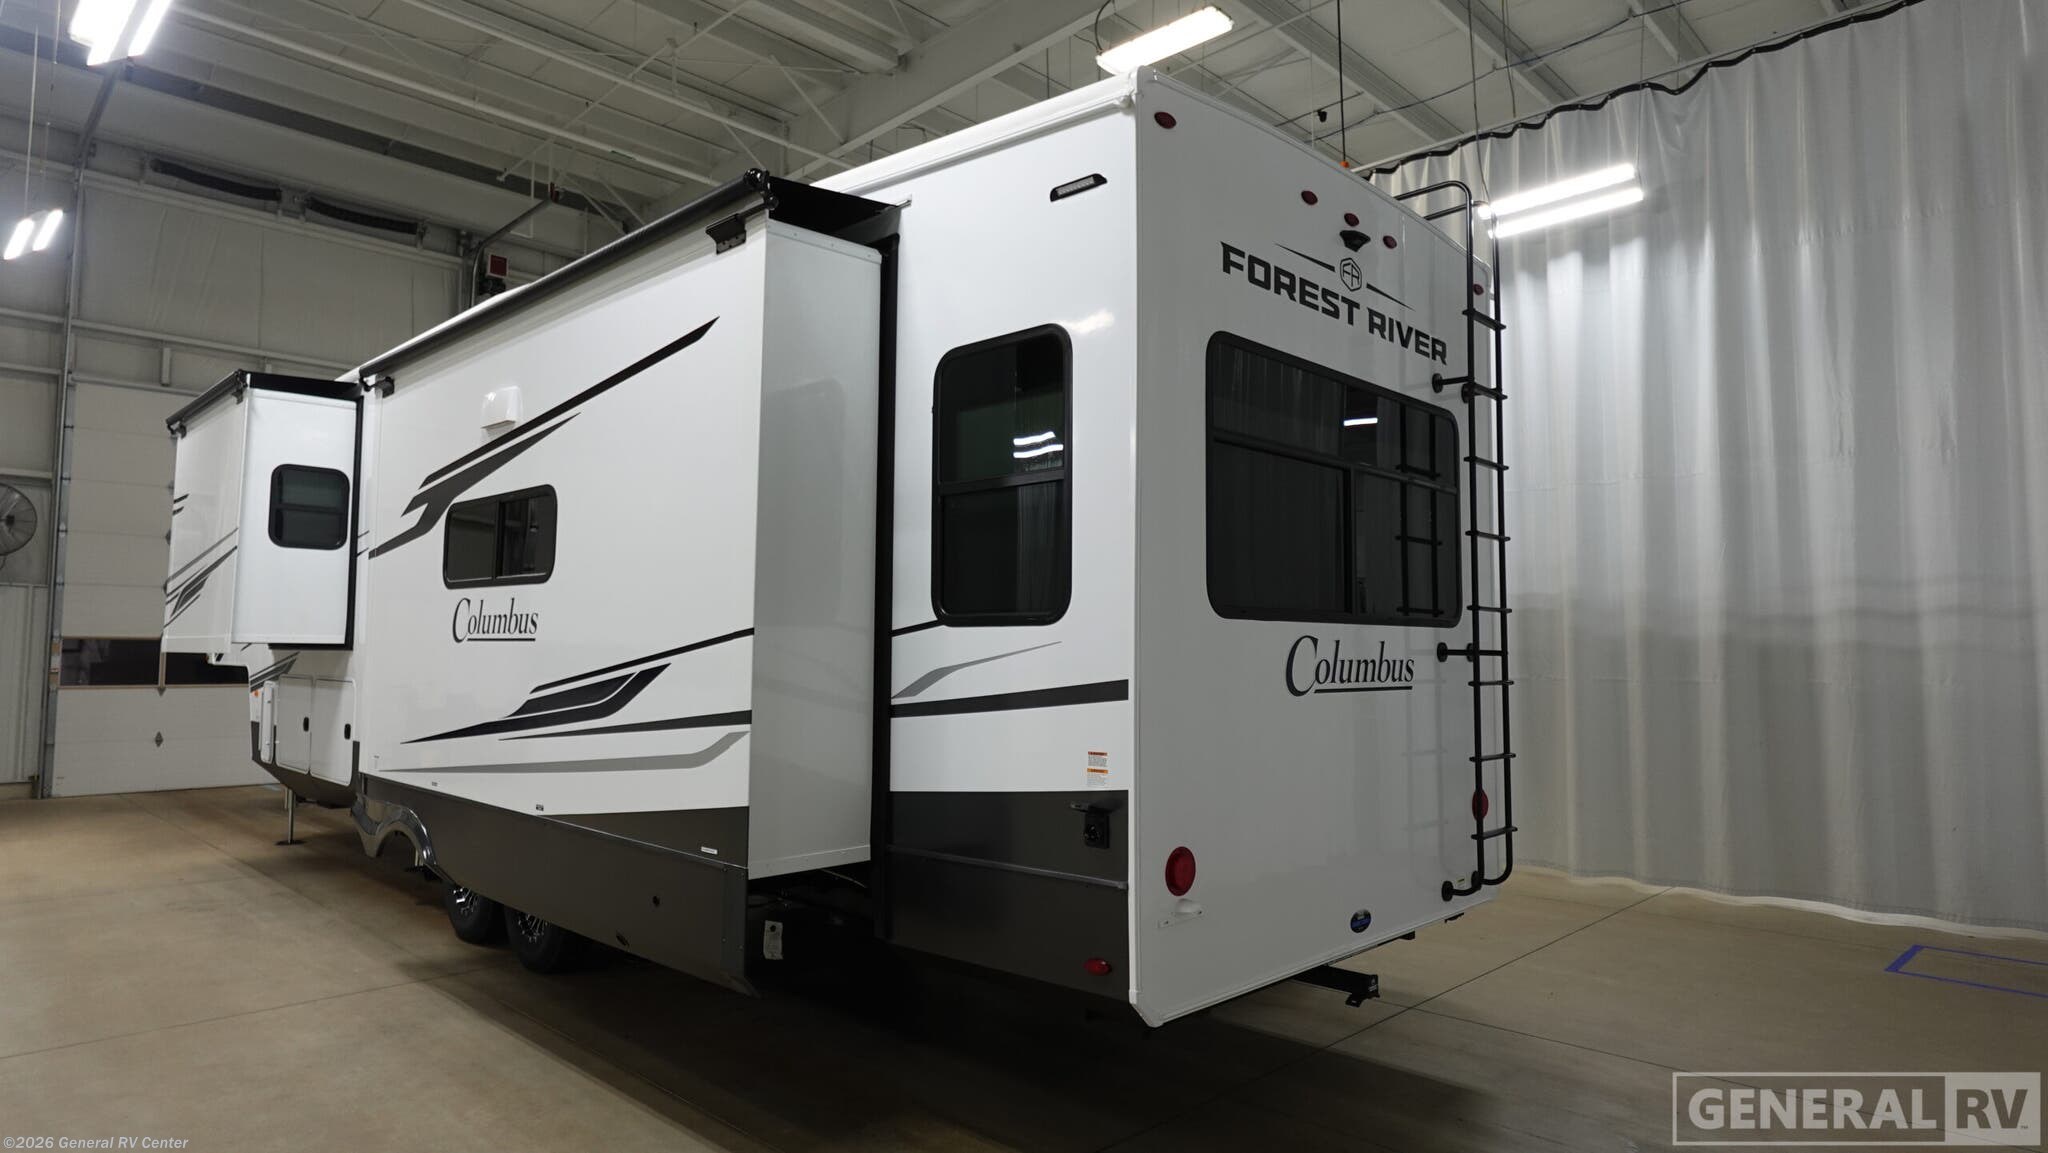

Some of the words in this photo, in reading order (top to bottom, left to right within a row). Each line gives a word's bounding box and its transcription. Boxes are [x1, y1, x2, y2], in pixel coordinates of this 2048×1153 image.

[1220, 241, 1360, 326] FOREST
[1367, 307, 1447, 365] RIVER
[452, 597, 539, 643] Columbus
[1285, 635, 1415, 697] Columbus
